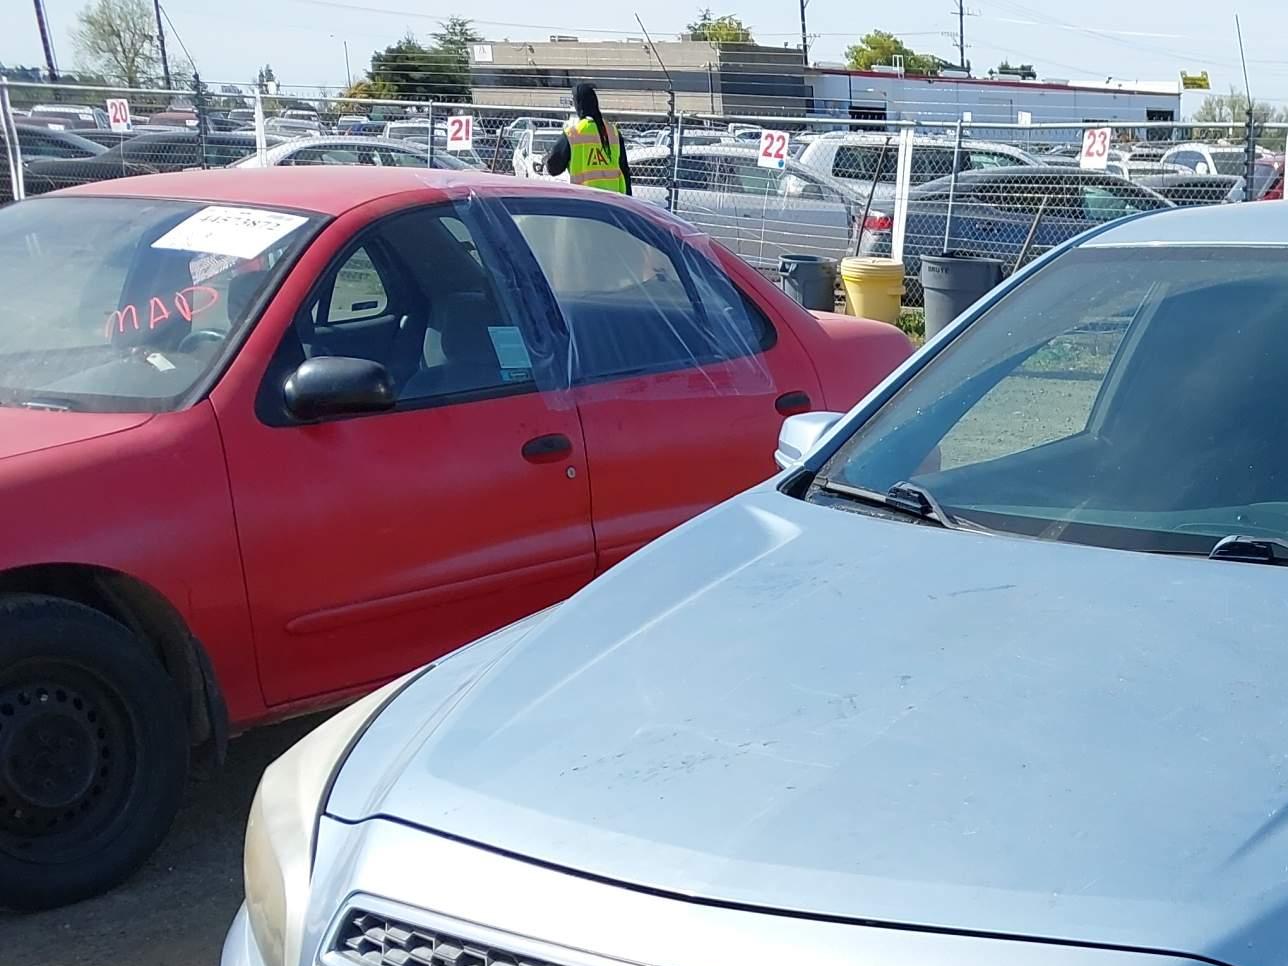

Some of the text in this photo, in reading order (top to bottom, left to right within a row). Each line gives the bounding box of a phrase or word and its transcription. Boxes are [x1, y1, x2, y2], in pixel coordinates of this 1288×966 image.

[110, 102, 128, 123] 20
[450, 118, 470, 141] 21
[762, 133, 786, 159] 22
[1085, 130, 1107, 157] 23
